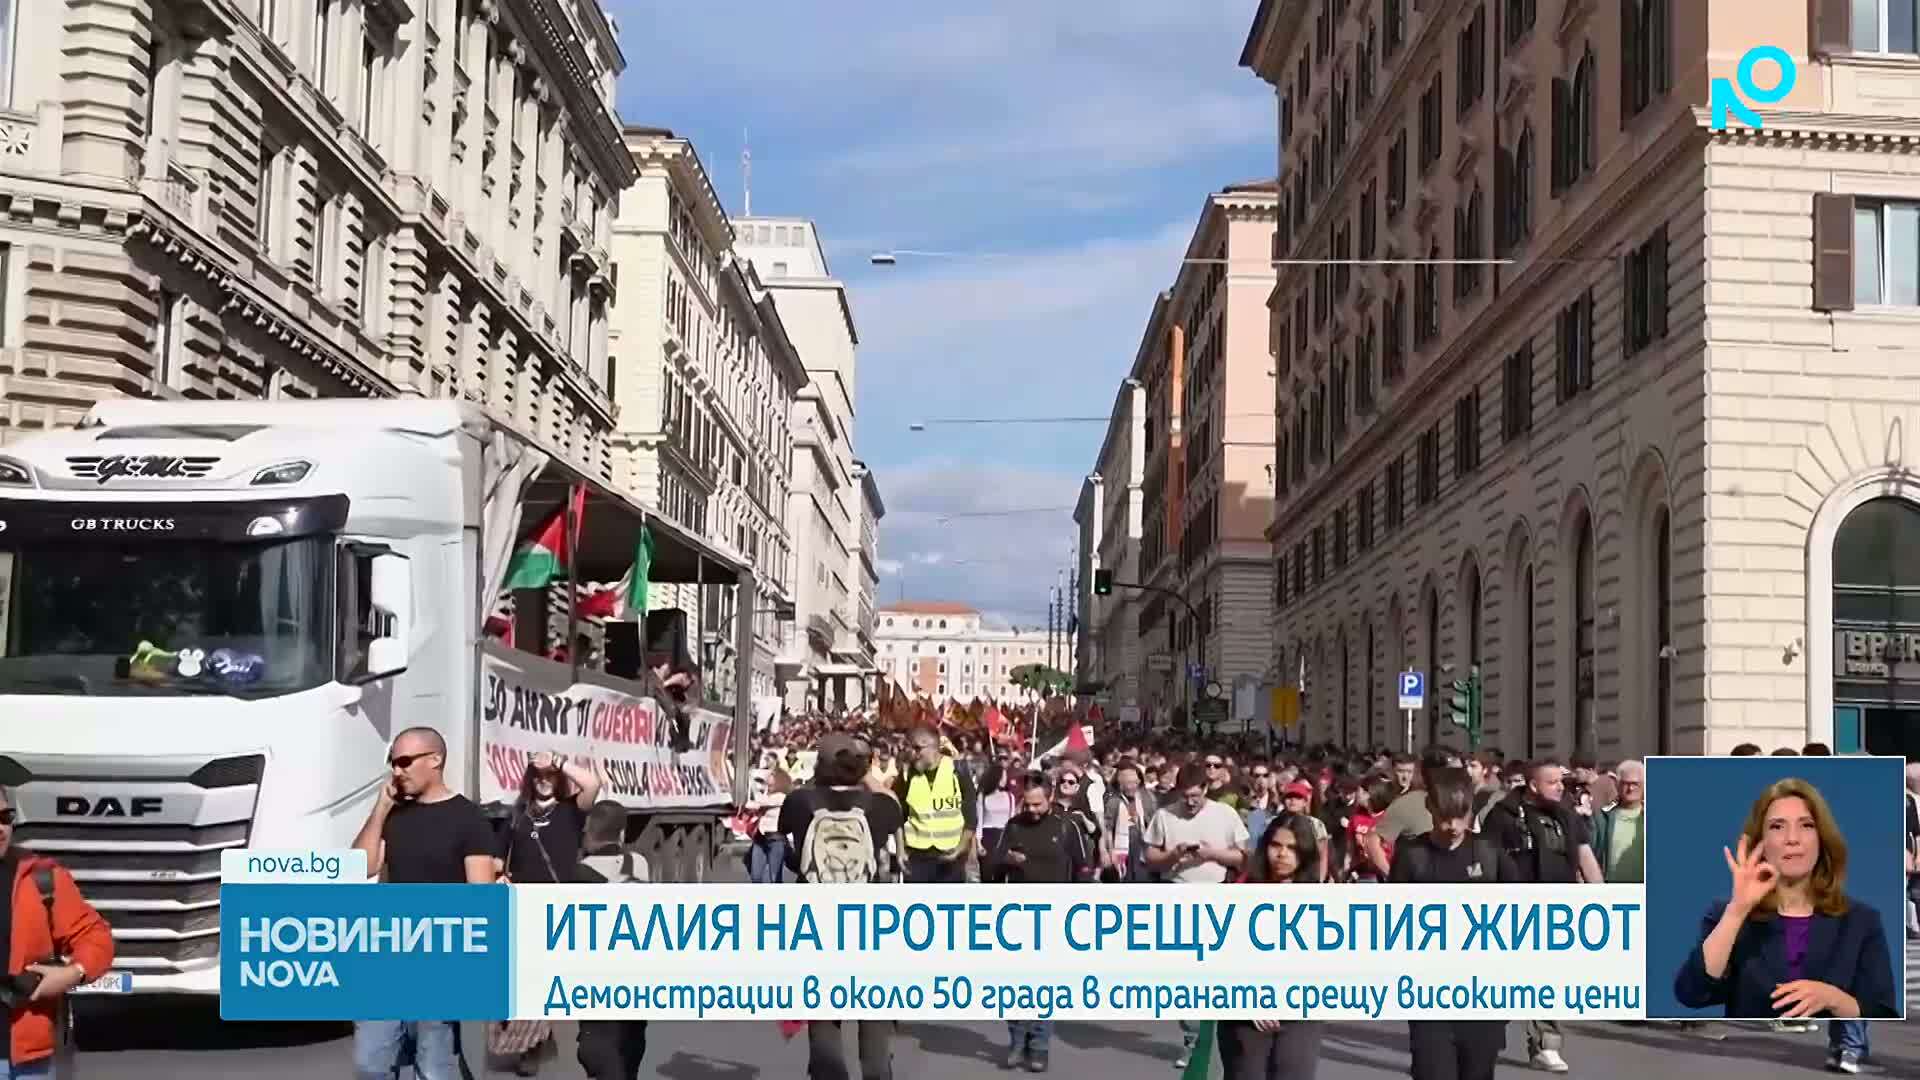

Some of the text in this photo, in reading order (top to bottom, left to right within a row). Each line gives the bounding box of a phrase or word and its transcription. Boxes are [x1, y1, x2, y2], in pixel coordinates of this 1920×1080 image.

[71, 519, 175, 530] GB TRUCKS
[1404, 675, 1418, 694] P
[485, 674, 506, 724] 30
[510, 686, 573, 735] ANNI
[57, 796, 163, 817] DAF
